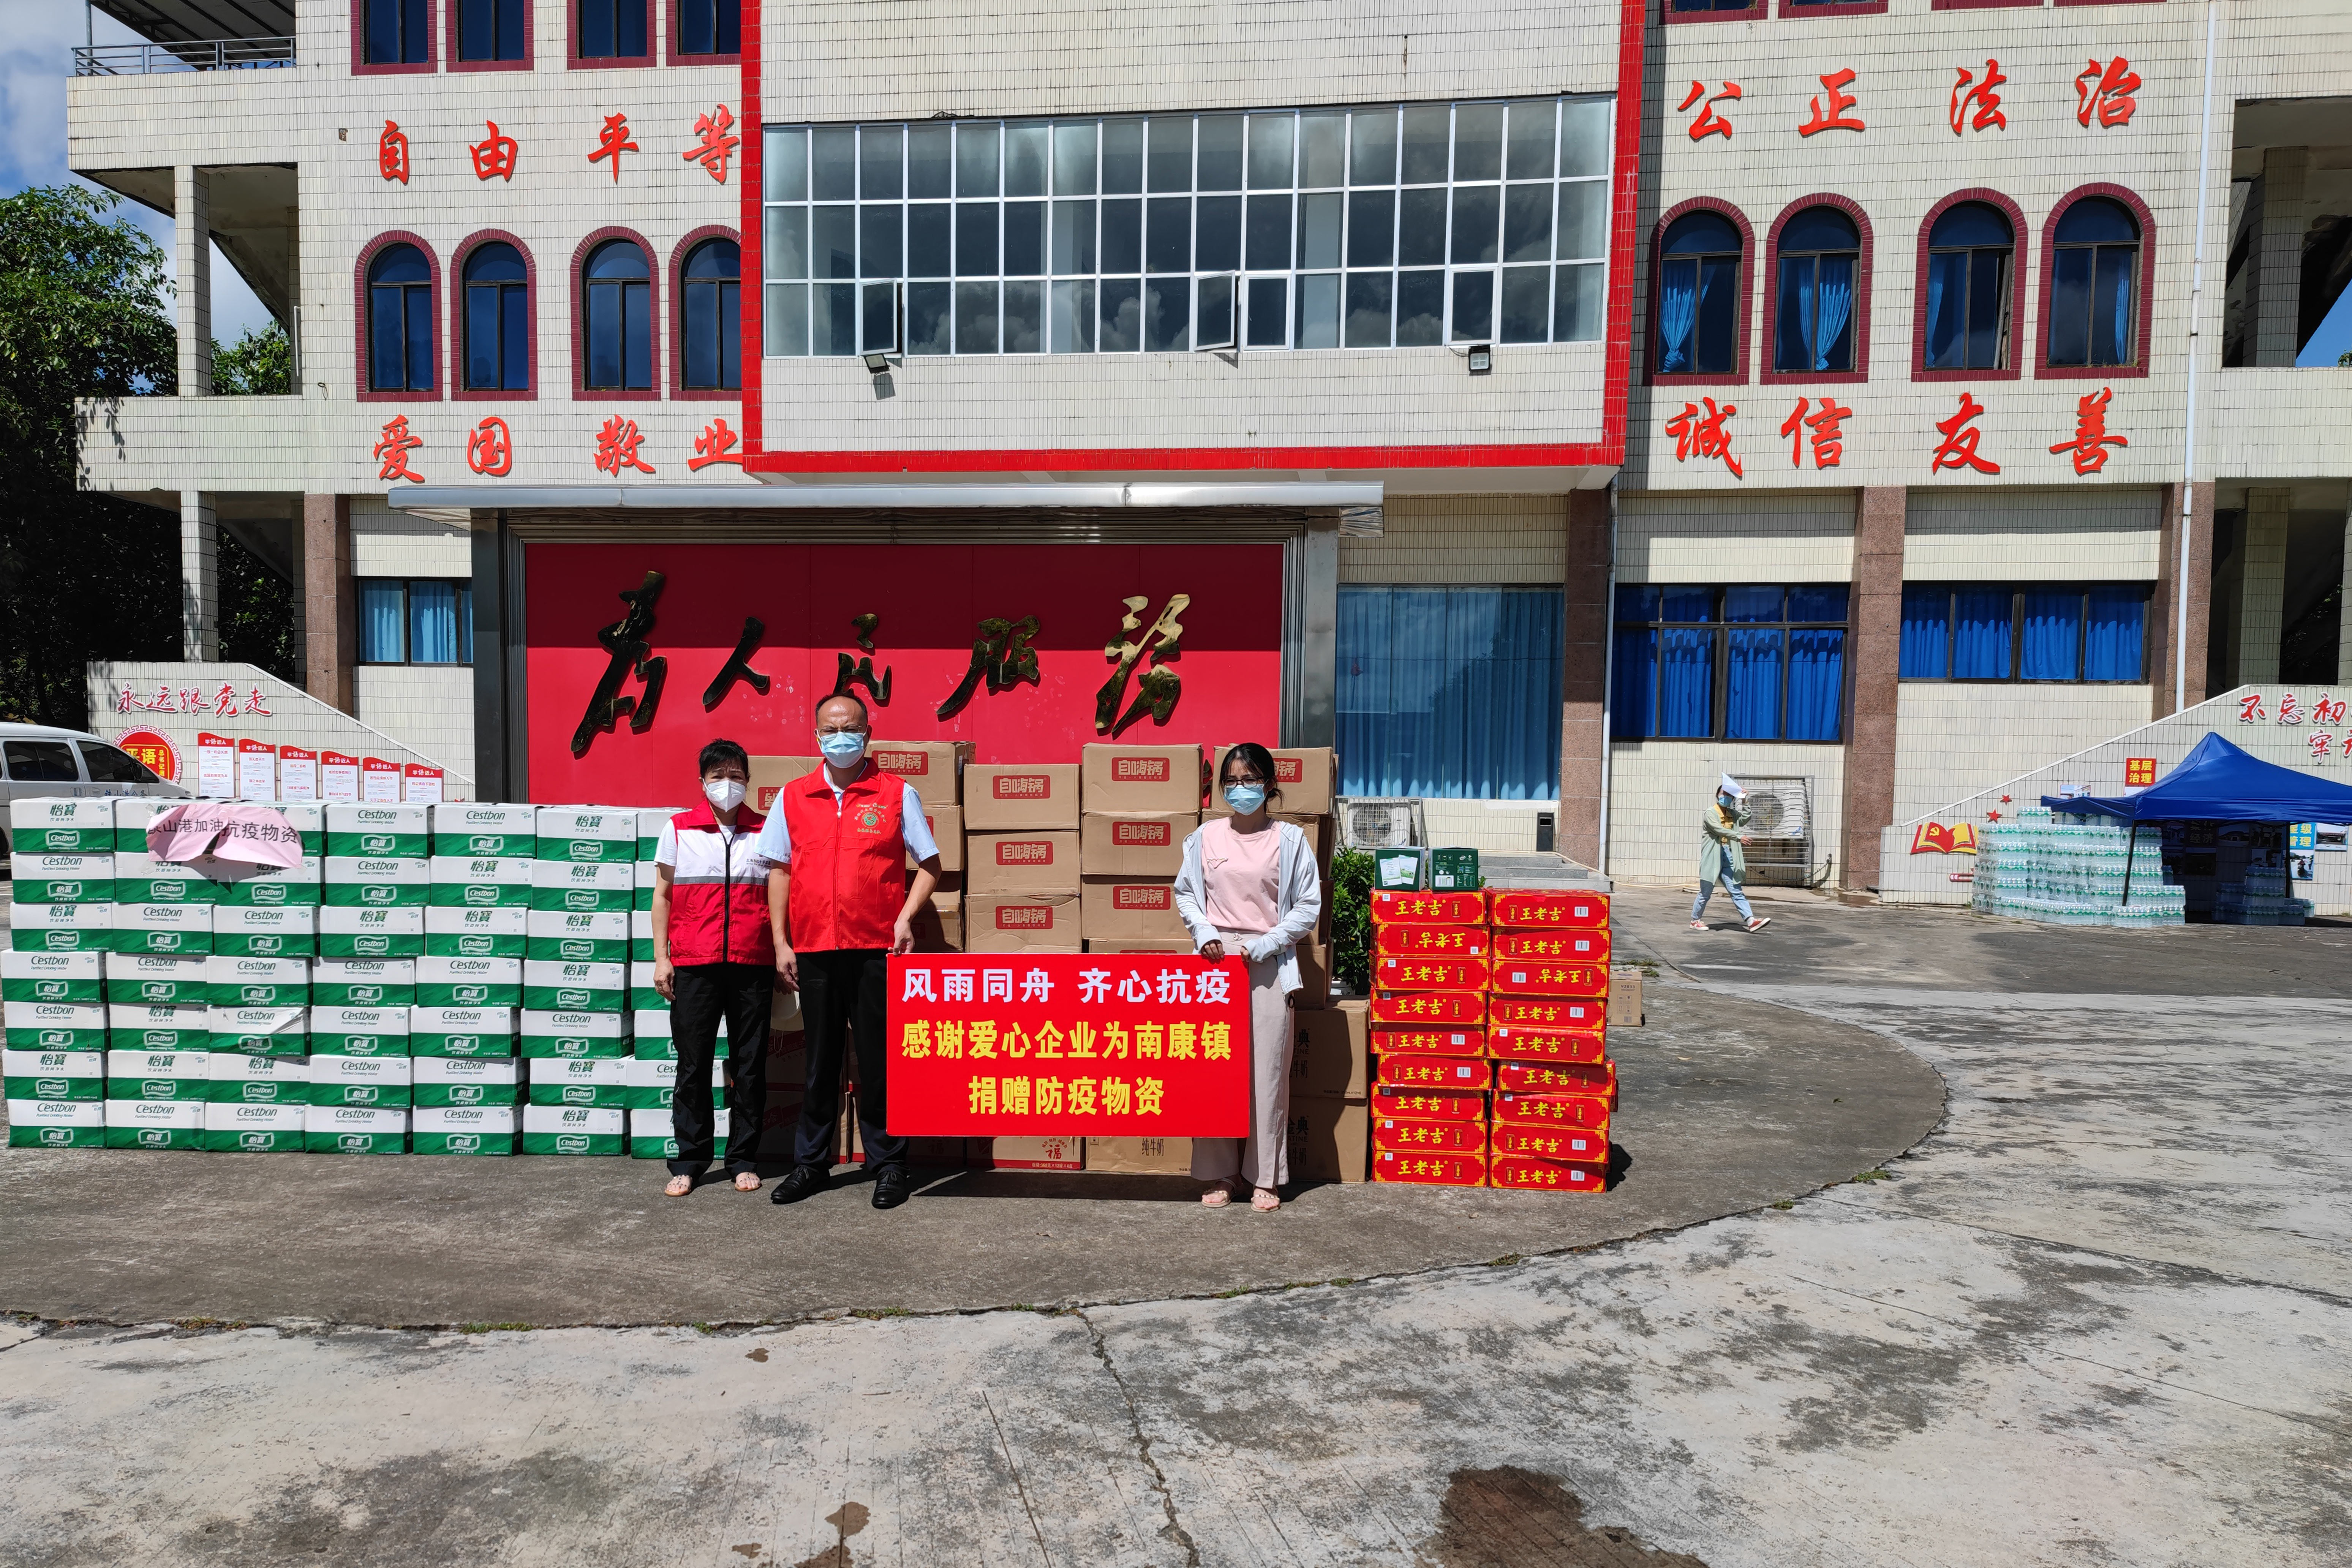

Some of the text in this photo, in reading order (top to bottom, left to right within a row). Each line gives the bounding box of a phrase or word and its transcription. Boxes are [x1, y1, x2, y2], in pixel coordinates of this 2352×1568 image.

[117, 682, 273, 717] 永远跟党走
[2239, 692, 2352, 725] 不忘初
[878, 753, 922, 769] 自嗨锅
[1119, 760, 1163, 775] 自嗨锅
[1000, 778, 1044, 795] 自嗨锅
[1119, 825, 1164, 841] 自嗨锅
[1003, 844, 1046, 861] 自嗨锅
[1120, 888, 1164, 905] 自嗨锅
[1395, 899, 1442, 915] 王老吉
[1520, 907, 1562, 921] 王老吉
[1002, 909, 1046, 923] 自嗨锅
[1419, 932, 1465, 948] 王老吉
[1521, 940, 1562, 955] 王老吉
[1401, 966, 1447, 982] 王老吉
[1539, 969, 1581, 983] 王老吉
[902, 968, 1231, 1004] 风雨同舟 齐心抗疫
[1396, 999, 1443, 1015] 王老吉
[1515, 1007, 1557, 1021] 王老吉
[901, 1020, 1232, 1061] 感谢爱心企业为南康镇
[1398, 1034, 1438, 1048] 王老吉
[1513, 1037, 1560, 1053] 王老吉
[1404, 1067, 1444, 1081] 王老吉
[1524, 1069, 1571, 1085] 王老吉
[968, 1076, 1165, 1116] 捐赠防疫物资
[1396, 1095, 1442, 1111] 王老吉
[1518, 1102, 1565, 1118] 王老吉
[1398, 1127, 1444, 1144] 王老吉
[1045, 1144, 1062, 1159] 福
[1141, 1137, 1164, 1157] 纯牛奶
[1517, 1138, 1559, 1152] 王老吉
[1398, 1160, 1444, 1176] 王老吉
[1517, 1170, 1558, 1184] 王老吉
